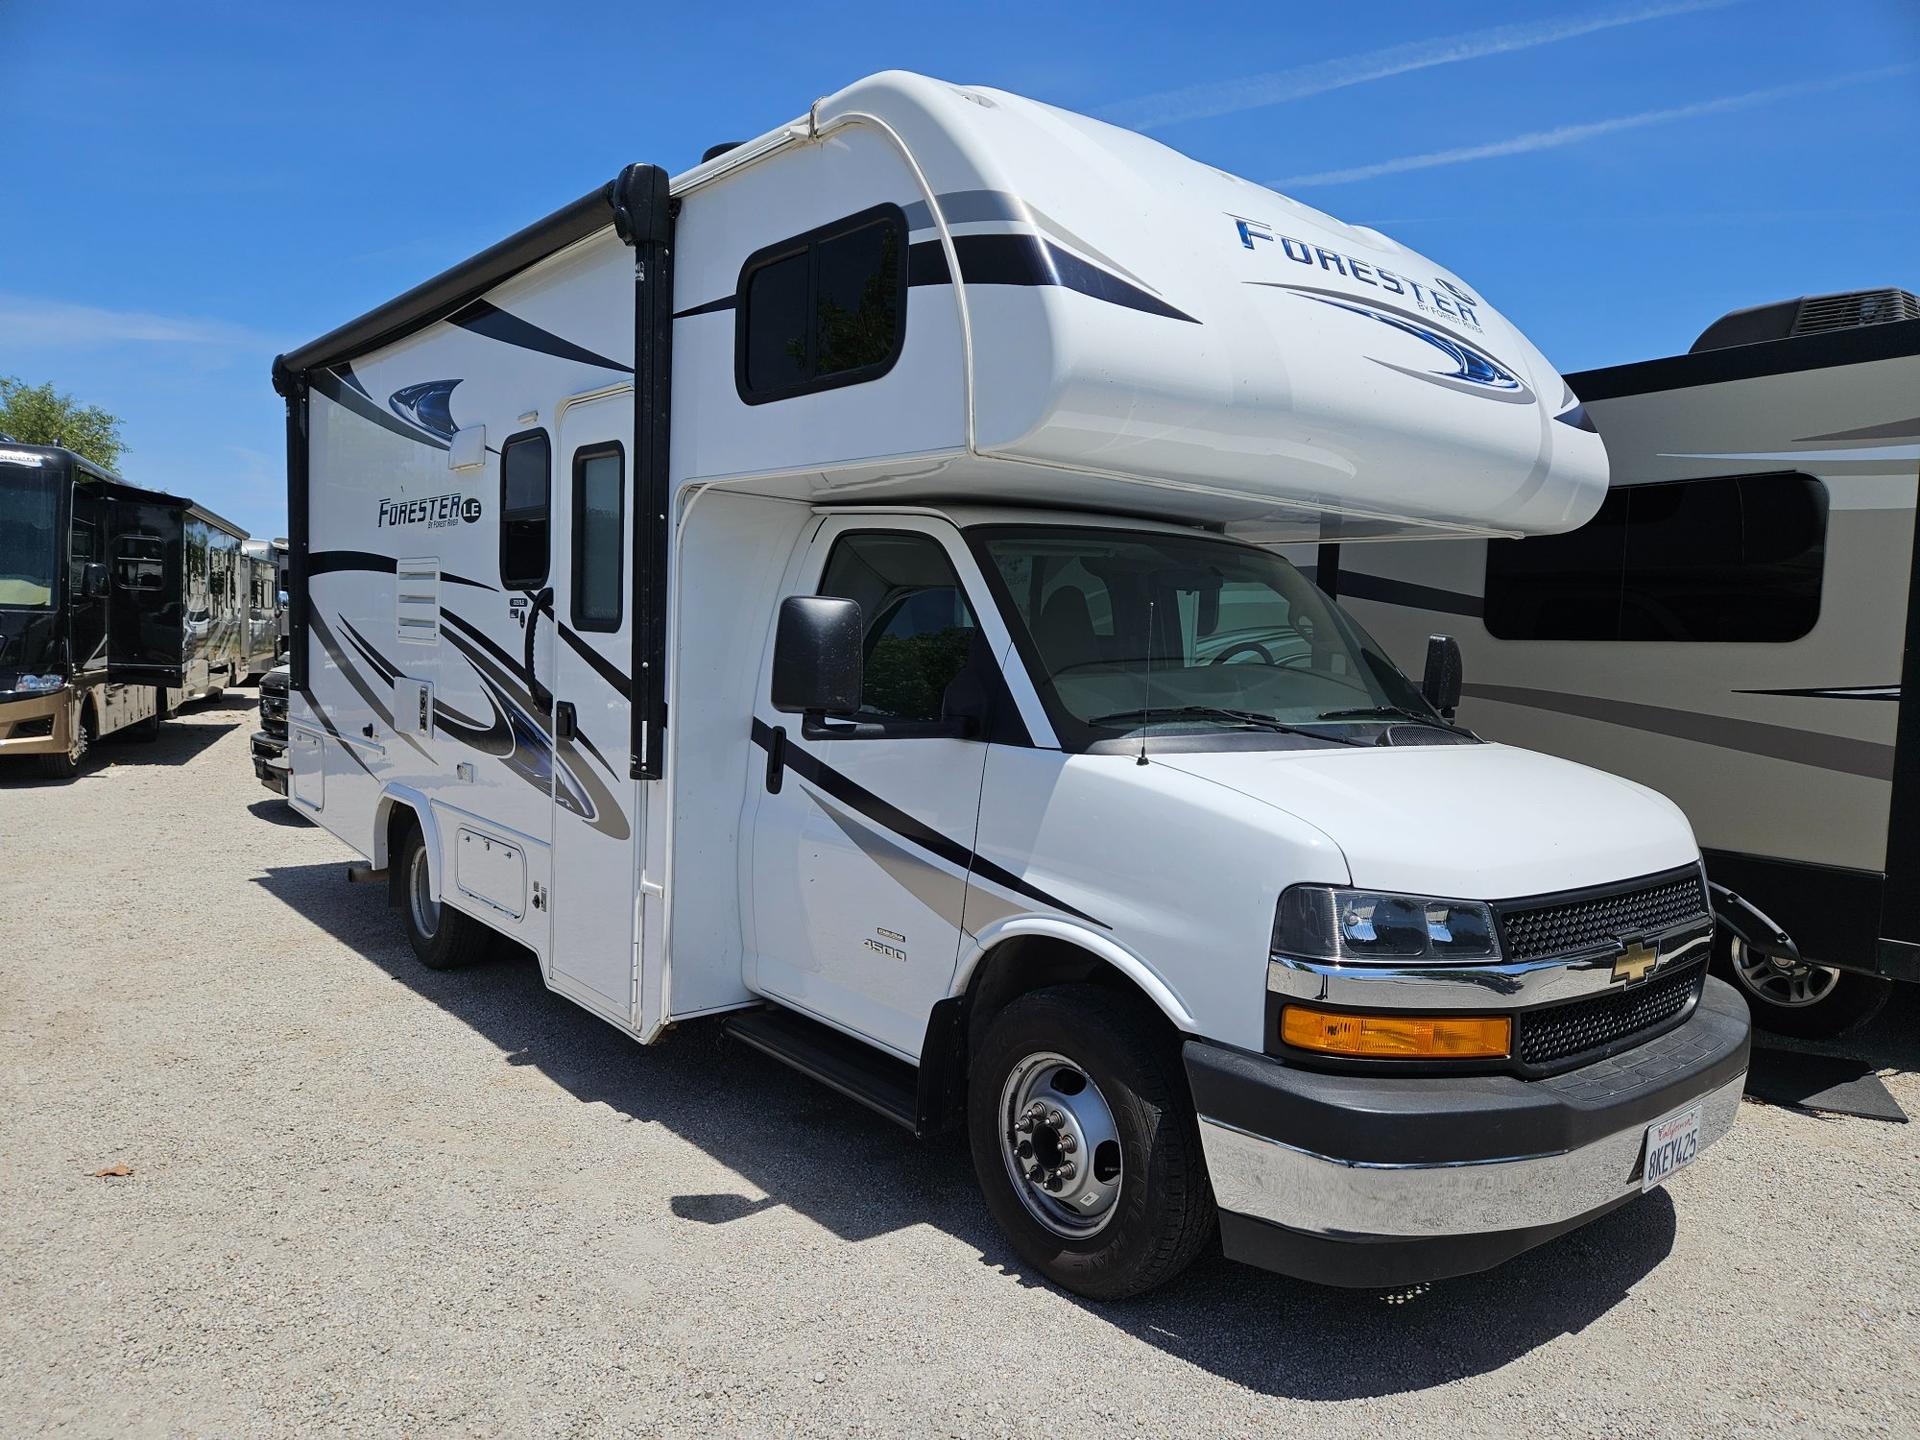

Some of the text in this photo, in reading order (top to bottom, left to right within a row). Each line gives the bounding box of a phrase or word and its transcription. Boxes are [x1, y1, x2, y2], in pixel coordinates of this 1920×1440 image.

[1228, 213, 1481, 327] FORESTER
[1416, 301, 1486, 335] BY FOREST RIVER
[378, 493, 480, 527] FORESTER LE
[864, 938, 906, 961] 4500
[1647, 1128, 1698, 1180] 8KEY425
